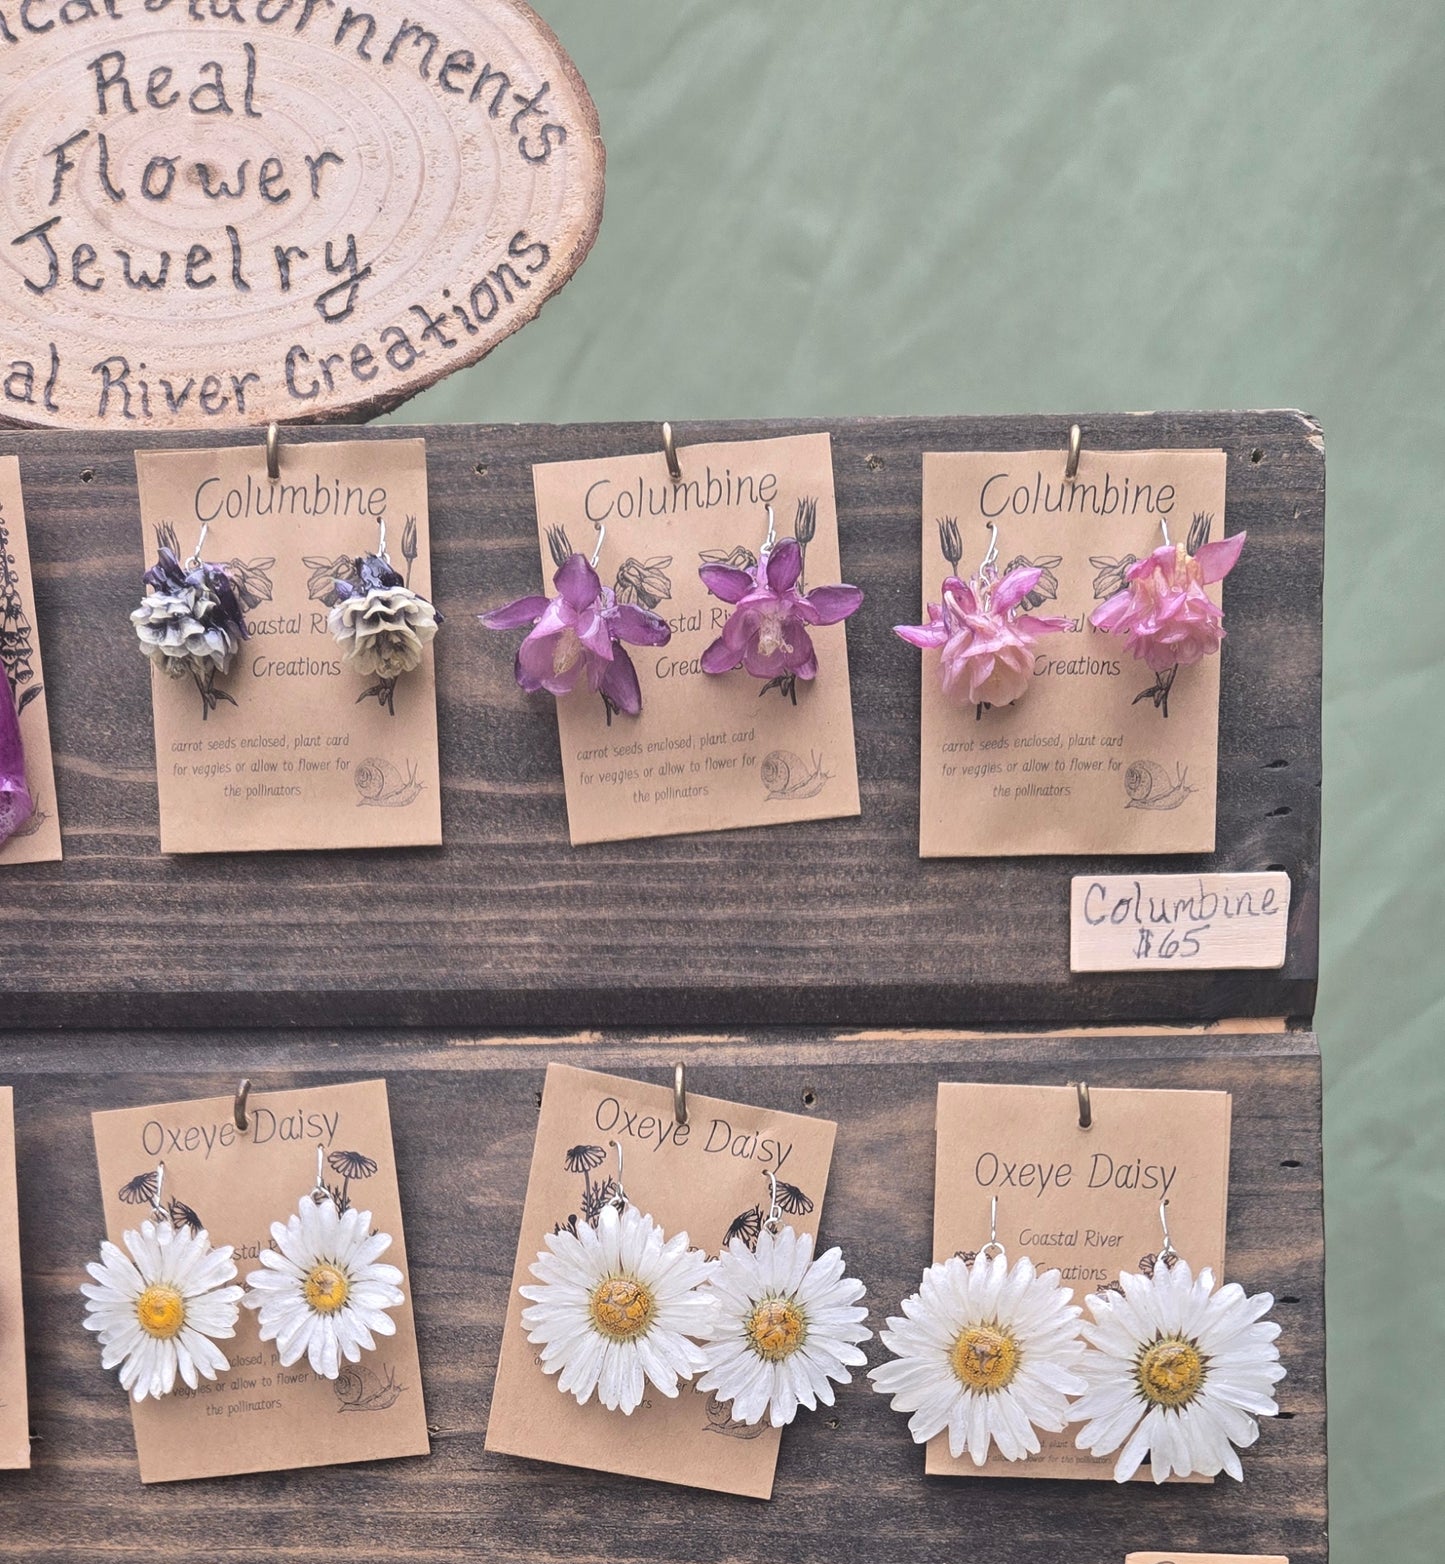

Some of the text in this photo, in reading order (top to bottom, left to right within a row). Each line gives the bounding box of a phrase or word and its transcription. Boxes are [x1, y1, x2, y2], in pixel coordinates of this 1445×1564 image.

[87, 42, 262, 118] Real
[43, 128, 344, 206] Flower
[10, 214, 373, 325] Jewelry
[92, 355, 260, 421] River
[284, 230, 551, 402] Creations
[194, 474, 388, 522] Columbine
[583, 465, 779, 523] Columbine
[980, 472, 1176, 518] Columbine
[246, 613, 302, 636] oastal
[668, 613, 701, 634] stal
[251, 655, 342, 678] Creations
[1033, 654, 1122, 677] Creations
[171, 733, 350, 752] carrot seeds enclosed, plant card
[576, 745, 609, 761] carrot
[613, 741, 643, 758] seeds
[700, 732, 727, 749] plant
[731, 727, 755, 744] card
[942, 734, 1124, 753] carrot seeds enclosed, plant card
[173, 757, 351, 778] for veggies or allow to flower for
[580, 752, 757, 785] for veggies or allow to flower for
[942, 758, 1123, 778] for veggies or allow to flower for
[223, 783, 302, 801] the pollinators
[633, 785, 709, 804] the pollinators
[993, 783, 1072, 800] the pollinators
[1084, 880, 1280, 928] Columbine
[1133, 924, 1211, 960] $65
[141, 1107, 340, 1161] Oxeye Daisy
[595, 1096, 795, 1174] Oxeye Daisy
[975, 1151, 1177, 1199] Oxeye Daisy
[1018, 1228, 1124, 1247] Coastal River
[215, 1381, 226, 1392] or
[230, 1378, 257, 1391] allow
[262, 1376, 273, 1388] to
[277, 1372, 309, 1386] flower
[206, 1398, 282, 1418] the pollinators
